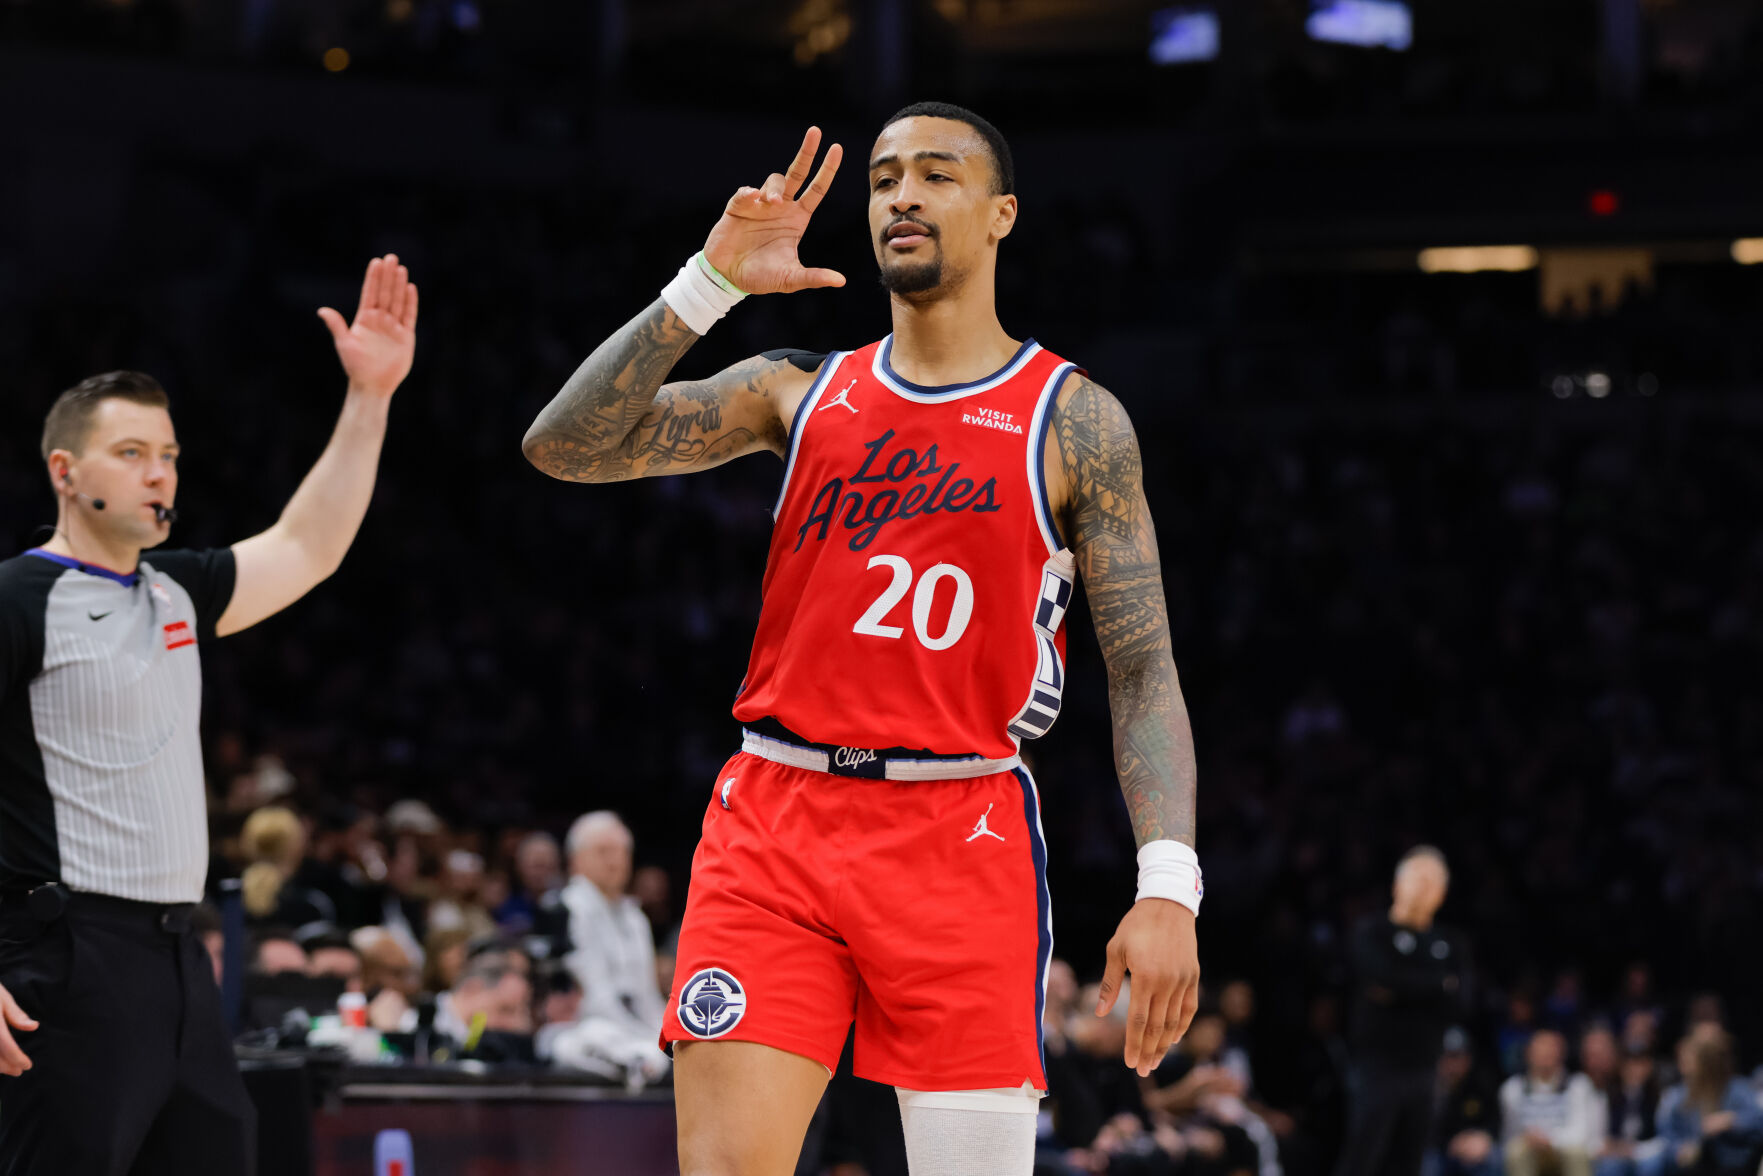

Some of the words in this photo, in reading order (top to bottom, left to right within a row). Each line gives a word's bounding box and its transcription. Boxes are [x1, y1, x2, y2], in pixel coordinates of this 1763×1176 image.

[962, 413, 1023, 434] RWANDA
[978, 407, 1014, 423] VISIT
[848, 428, 943, 485] Los
[793, 462, 1003, 552] Angeles
[852, 554, 974, 651] 20
[834, 746, 878, 770] Clips
